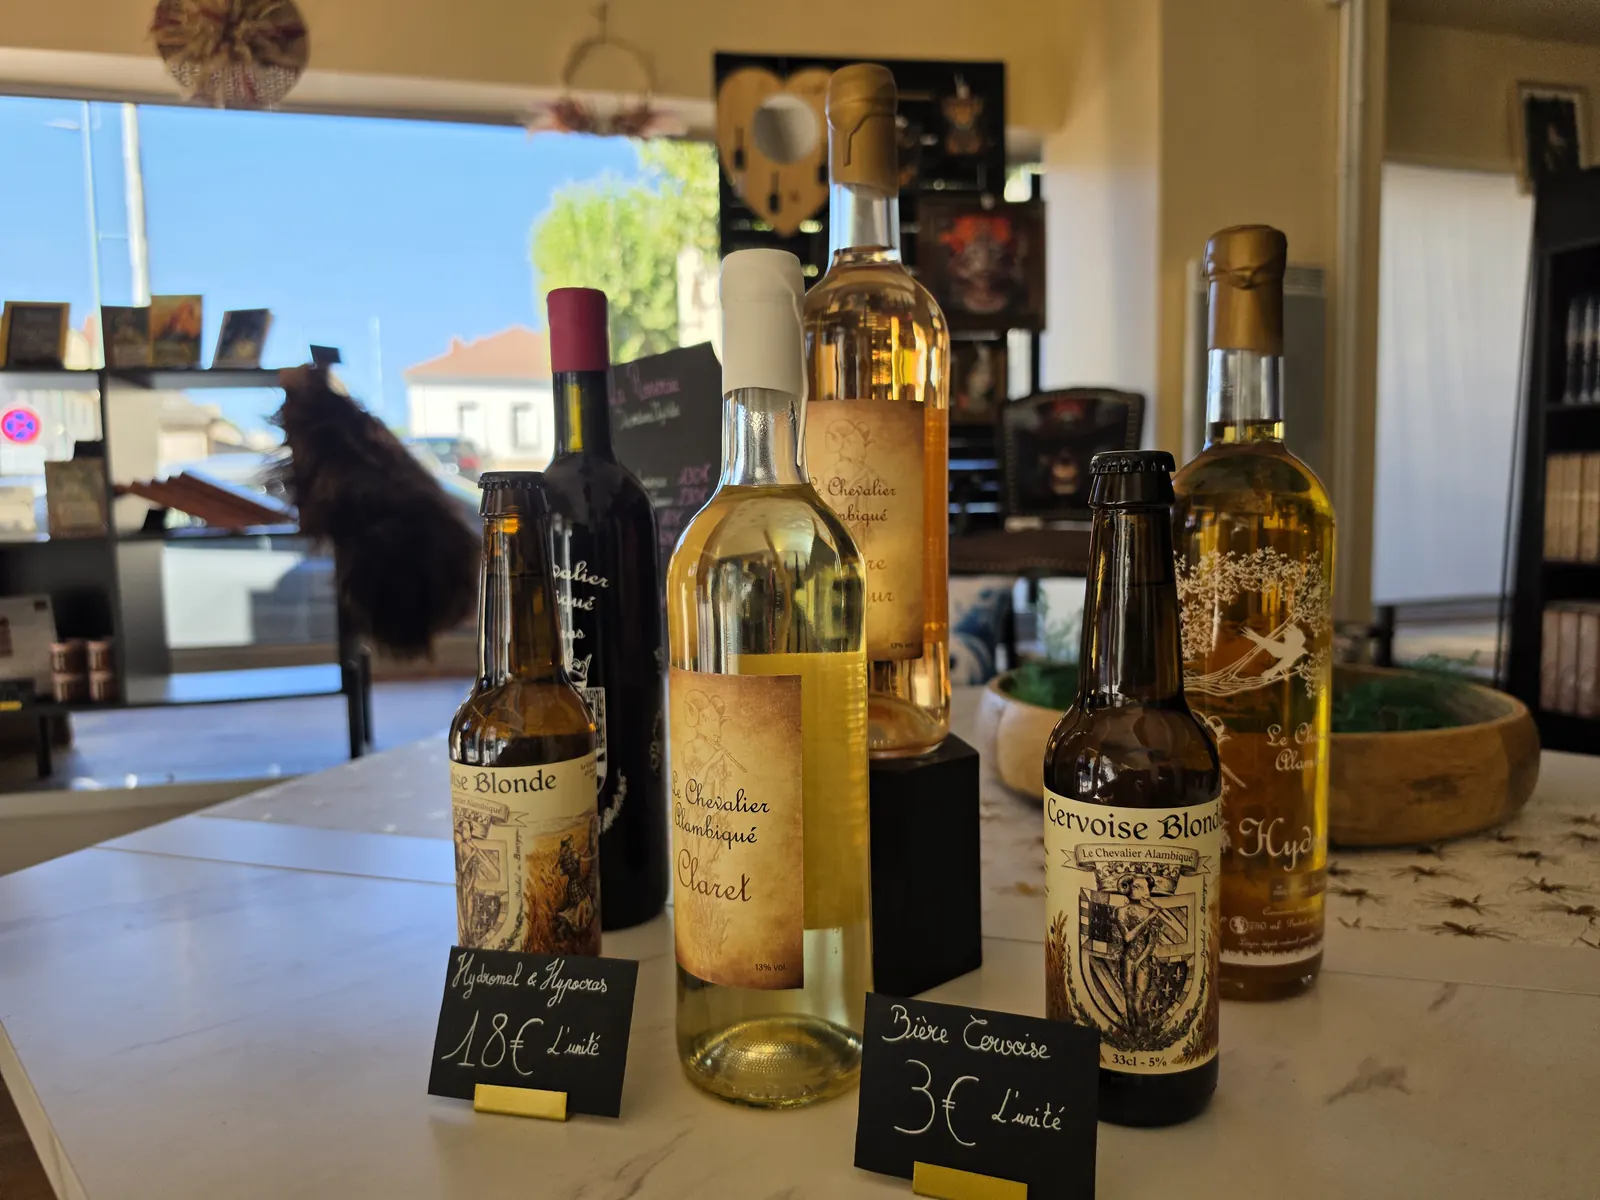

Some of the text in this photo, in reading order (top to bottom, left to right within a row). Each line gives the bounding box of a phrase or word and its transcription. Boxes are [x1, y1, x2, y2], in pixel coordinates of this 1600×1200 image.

[828, 476, 897, 497] Chevalier
[1265, 723, 1288, 747] Le
[473, 769, 557, 794] Blonde
[685, 778, 770, 813] Chevalier
[675, 801, 758, 850] Alambiqué
[1047, 798, 1220, 840] Cervoise Blond
[677, 848, 752, 902] Claret
[1082, 848, 1194, 863] Le Chevalier Alambiqué
[452, 951, 608, 1008] Hydromel & Hypocras
[441, 1010, 601, 1076] 18€ L'unité
[882, 1004, 1051, 1059] Bière Cervoise
[1112, 1053, 1137, 1067] 33cl
[1148, 1056, 1167, 1067] 5%
[893, 1059, 1065, 1146] 3€ L'unité
